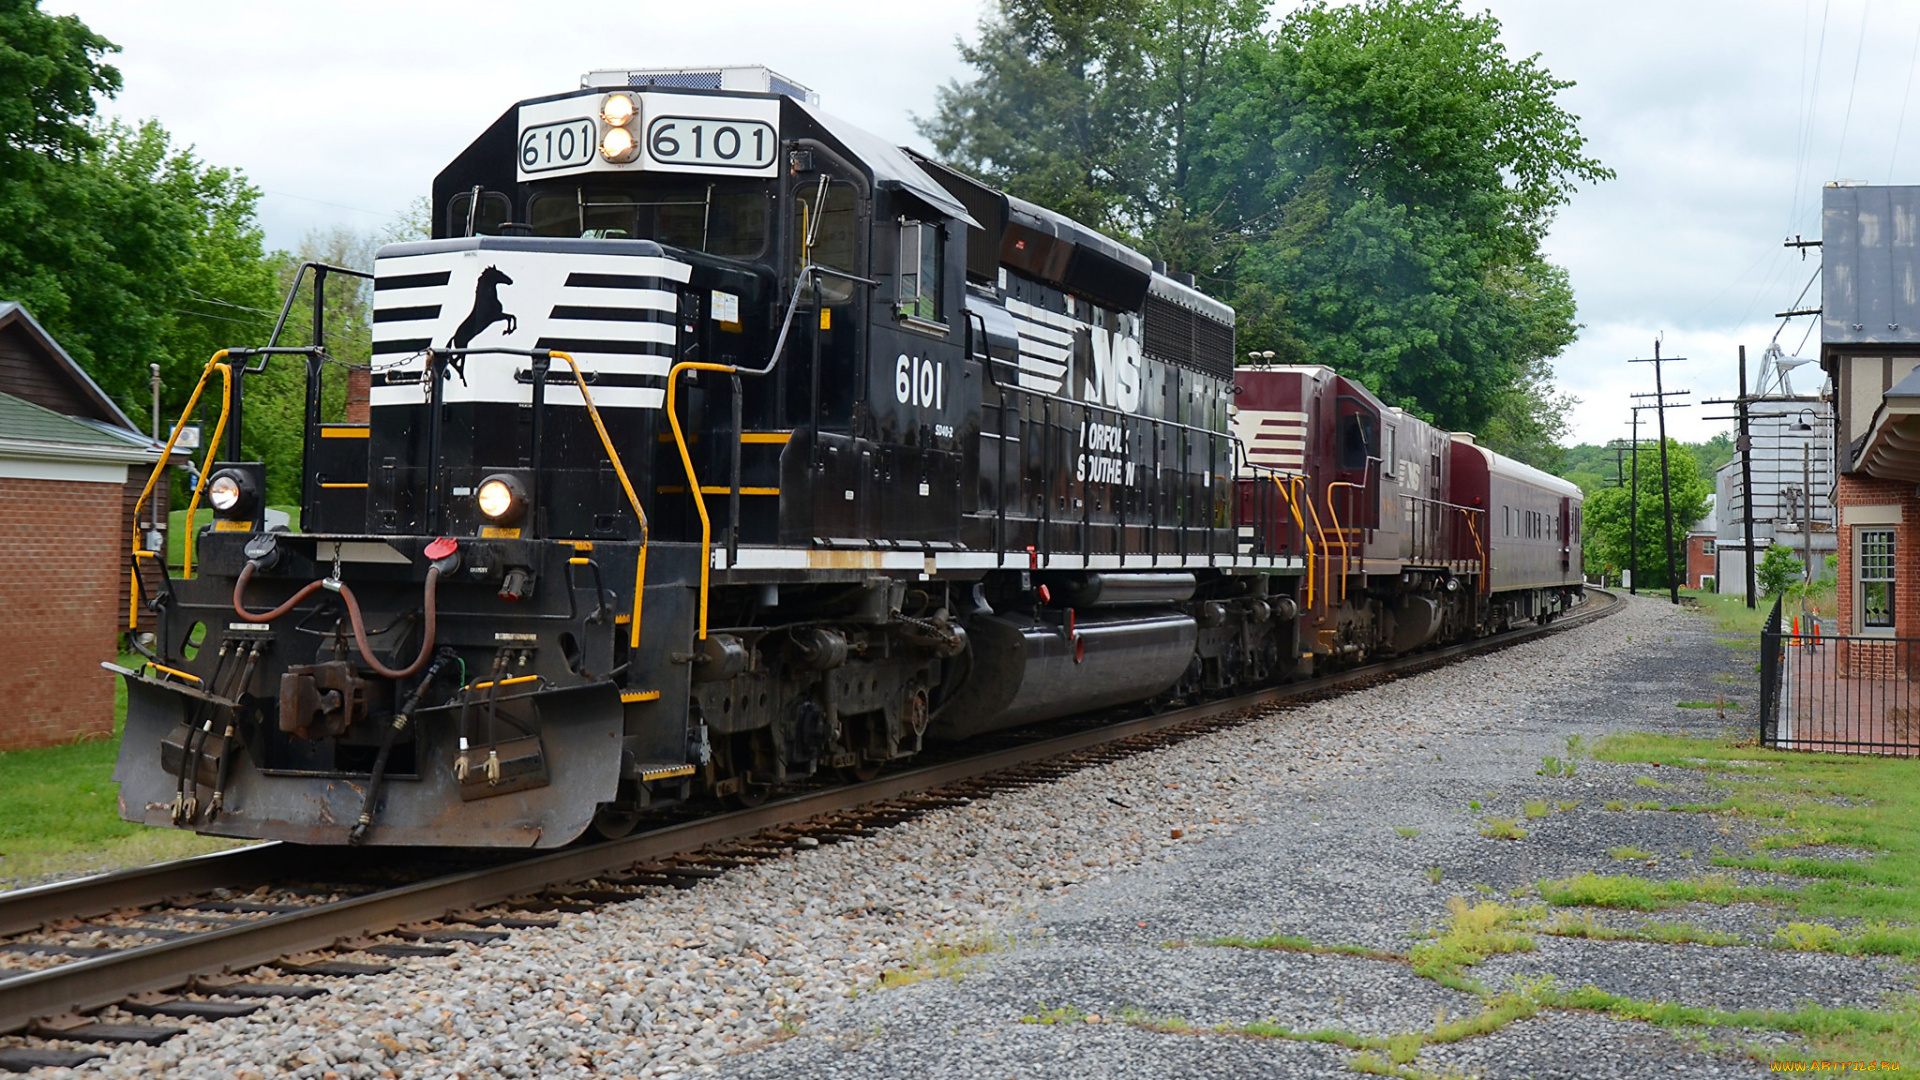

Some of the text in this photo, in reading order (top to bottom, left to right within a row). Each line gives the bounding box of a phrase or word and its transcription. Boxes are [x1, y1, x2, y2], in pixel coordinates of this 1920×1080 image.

[523, 124, 588, 166] 6101
[652, 123, 764, 162] 6101
[896, 354, 942, 410] 6101
[1083, 324, 1141, 413] NS
[935, 424, 954, 438] SD40-2
[1076, 453, 1136, 487] SOUTHEN
